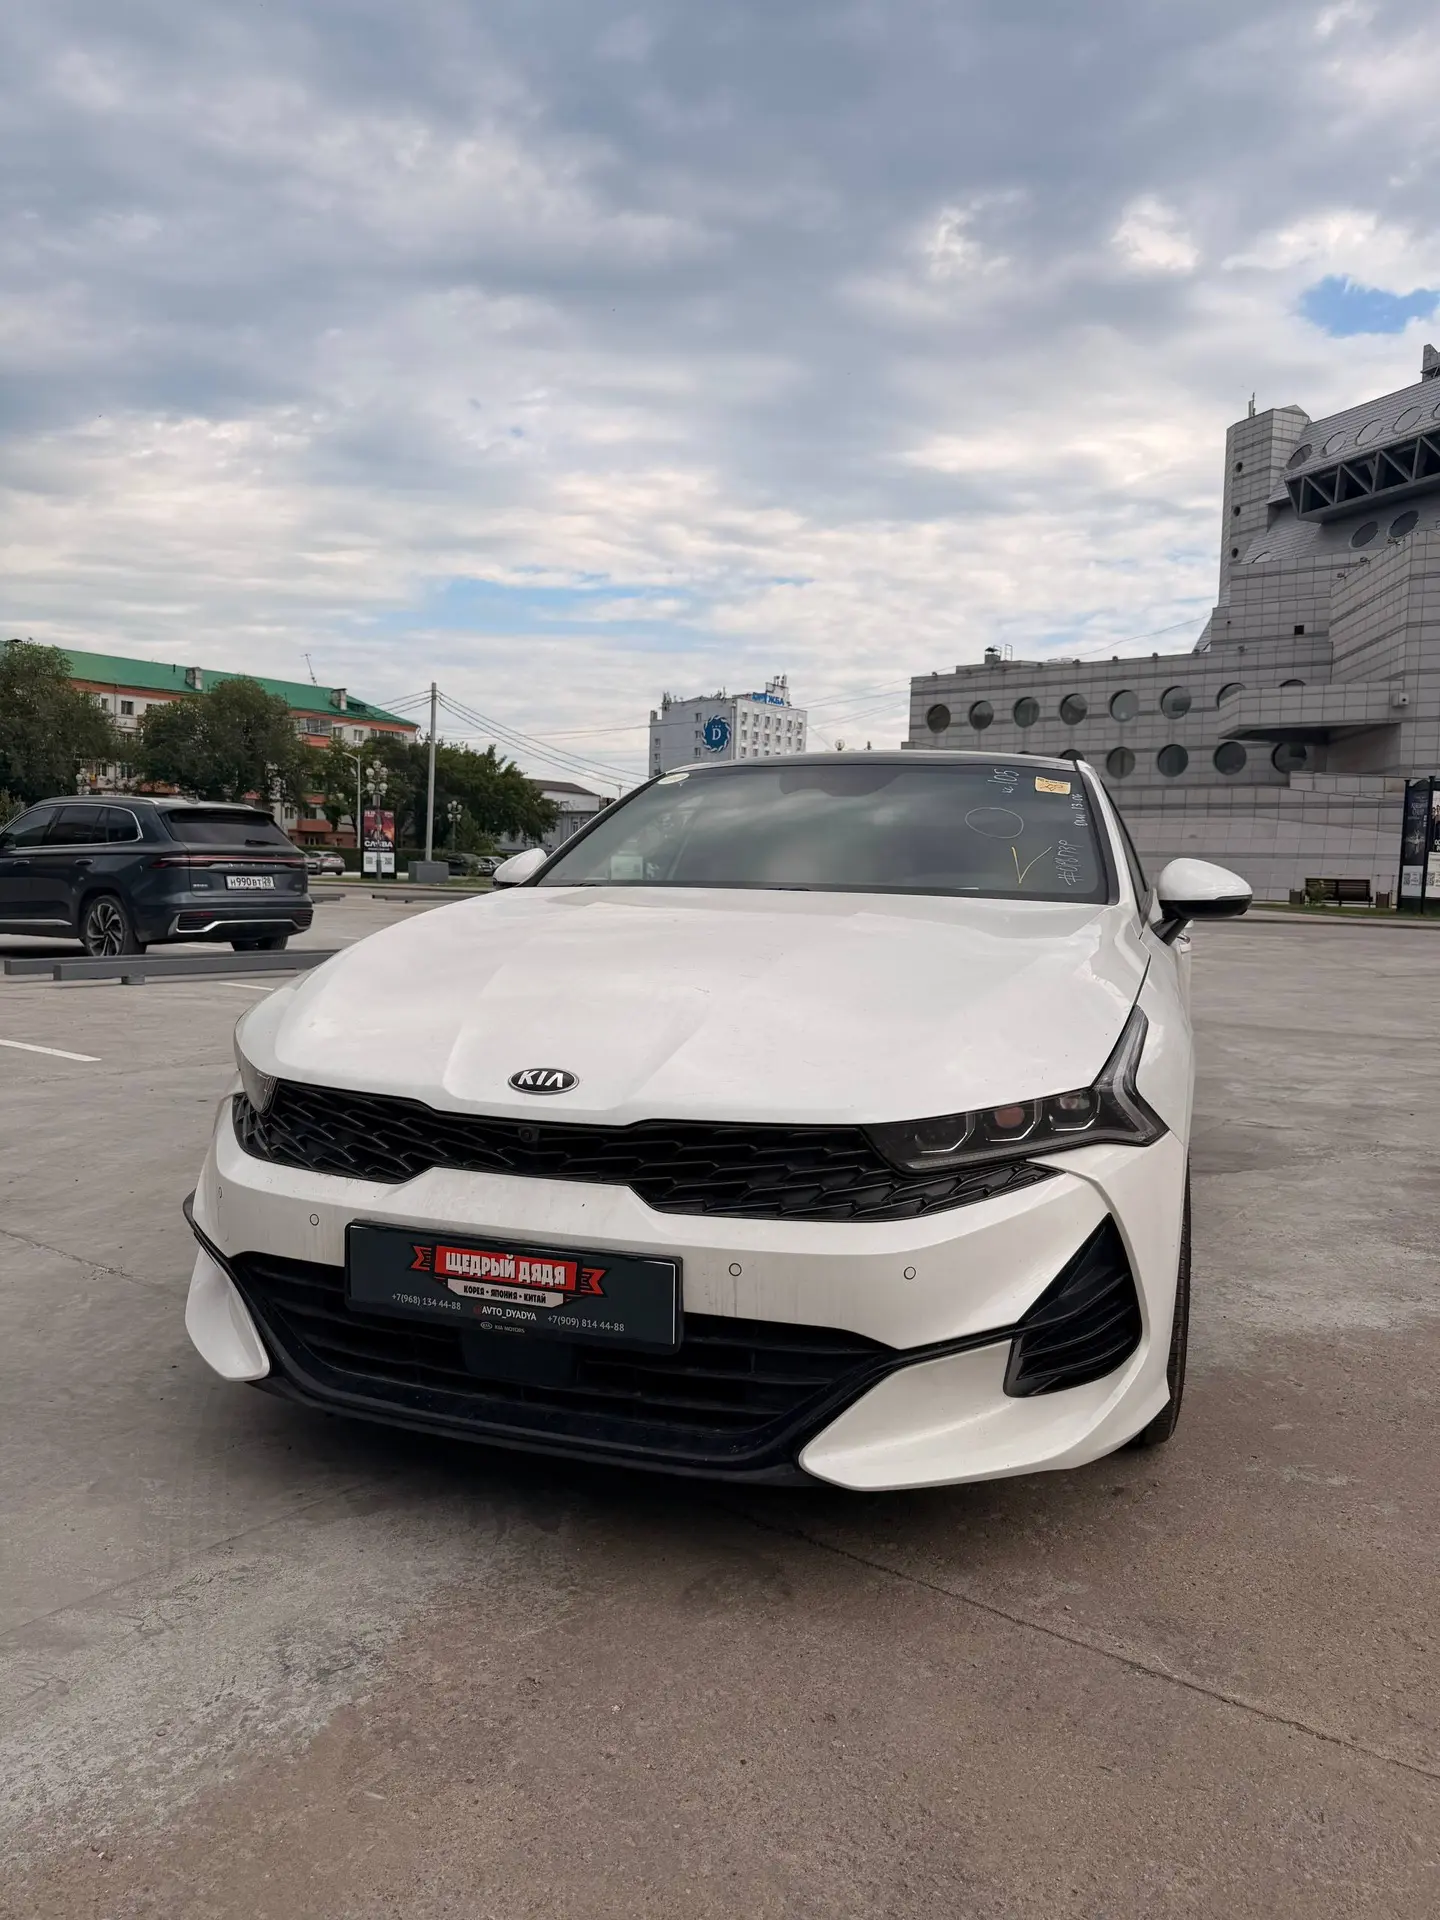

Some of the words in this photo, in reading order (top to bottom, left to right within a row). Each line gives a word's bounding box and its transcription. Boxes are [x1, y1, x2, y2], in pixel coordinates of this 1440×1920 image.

[517, 1070, 564, 1088] KIA
[445, 1252, 516, 1279] ЩЕДРЫЙ
[518, 1261, 565, 1286] ДЯДЯ
[392, 1293, 421, 1306] +7(968)
[422, 1297, 437, 1307] 134
[439, 1300, 462, 1311] 44-88
[463, 1285, 485, 1296] КОРЕЯ
[490, 1289, 517, 1300] ЯПОНИЯ
[523, 1293, 547, 1304] КИТАЙ
[481, 1306, 537, 1321] AVTO_DYADYA
[504, 1326, 526, 1334] MOTORS
[547, 1315, 580, 1328] +7(909)
[582, 1318, 597, 1328] 814
[599, 1322, 625, 1332] 44-88
